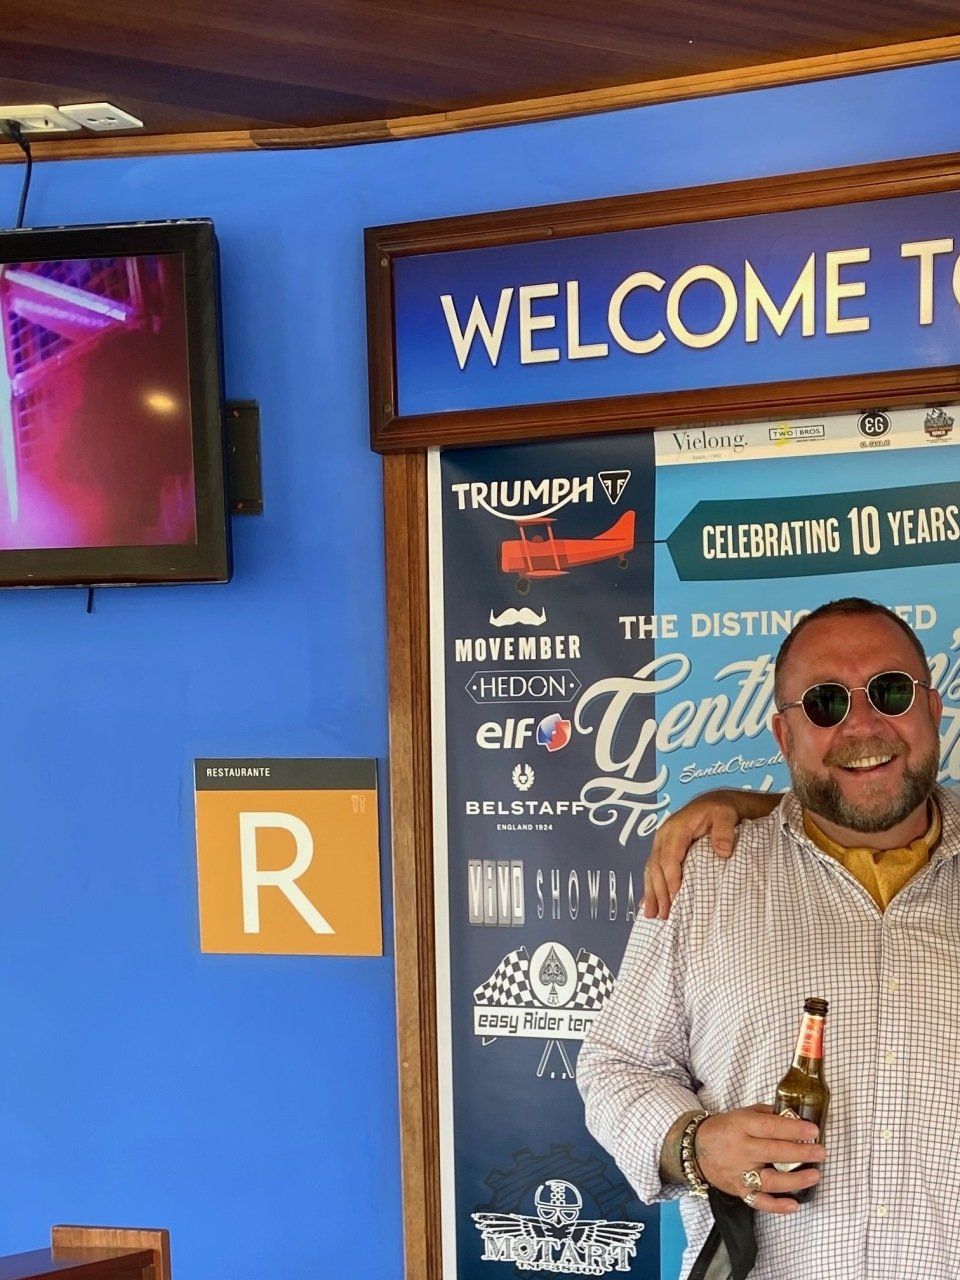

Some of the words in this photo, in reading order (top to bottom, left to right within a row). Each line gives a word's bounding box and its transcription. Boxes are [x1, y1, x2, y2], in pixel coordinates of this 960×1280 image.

[440, 247, 870, 370] WELCOME
[773, 429, 794, 437] TWO
[452, 477, 594, 520] TRIUMPH
[702, 518, 840, 560] CELEBRATING
[847, 506, 881, 556] 10
[887, 506, 960, 546] YEARS
[618, 614, 679, 639] THE
[454, 634, 581, 662] MOVEMBER
[480, 675, 567, 698] HEDON
[476, 717, 535, 749] elf
[206, 767, 271, 777] RESTAURANTE
[466, 801, 585, 815] BELSTAFF
[496, 823, 533, 831] ENGLAND
[535, 823, 553, 831] 1924
[239, 811, 336, 934] R
[536, 868, 636, 922] SHOWBA
[478, 1013, 519, 1034] easy
[523, 1011, 564, 1031] Rider
[481, 1235, 637, 1271] MOTART
